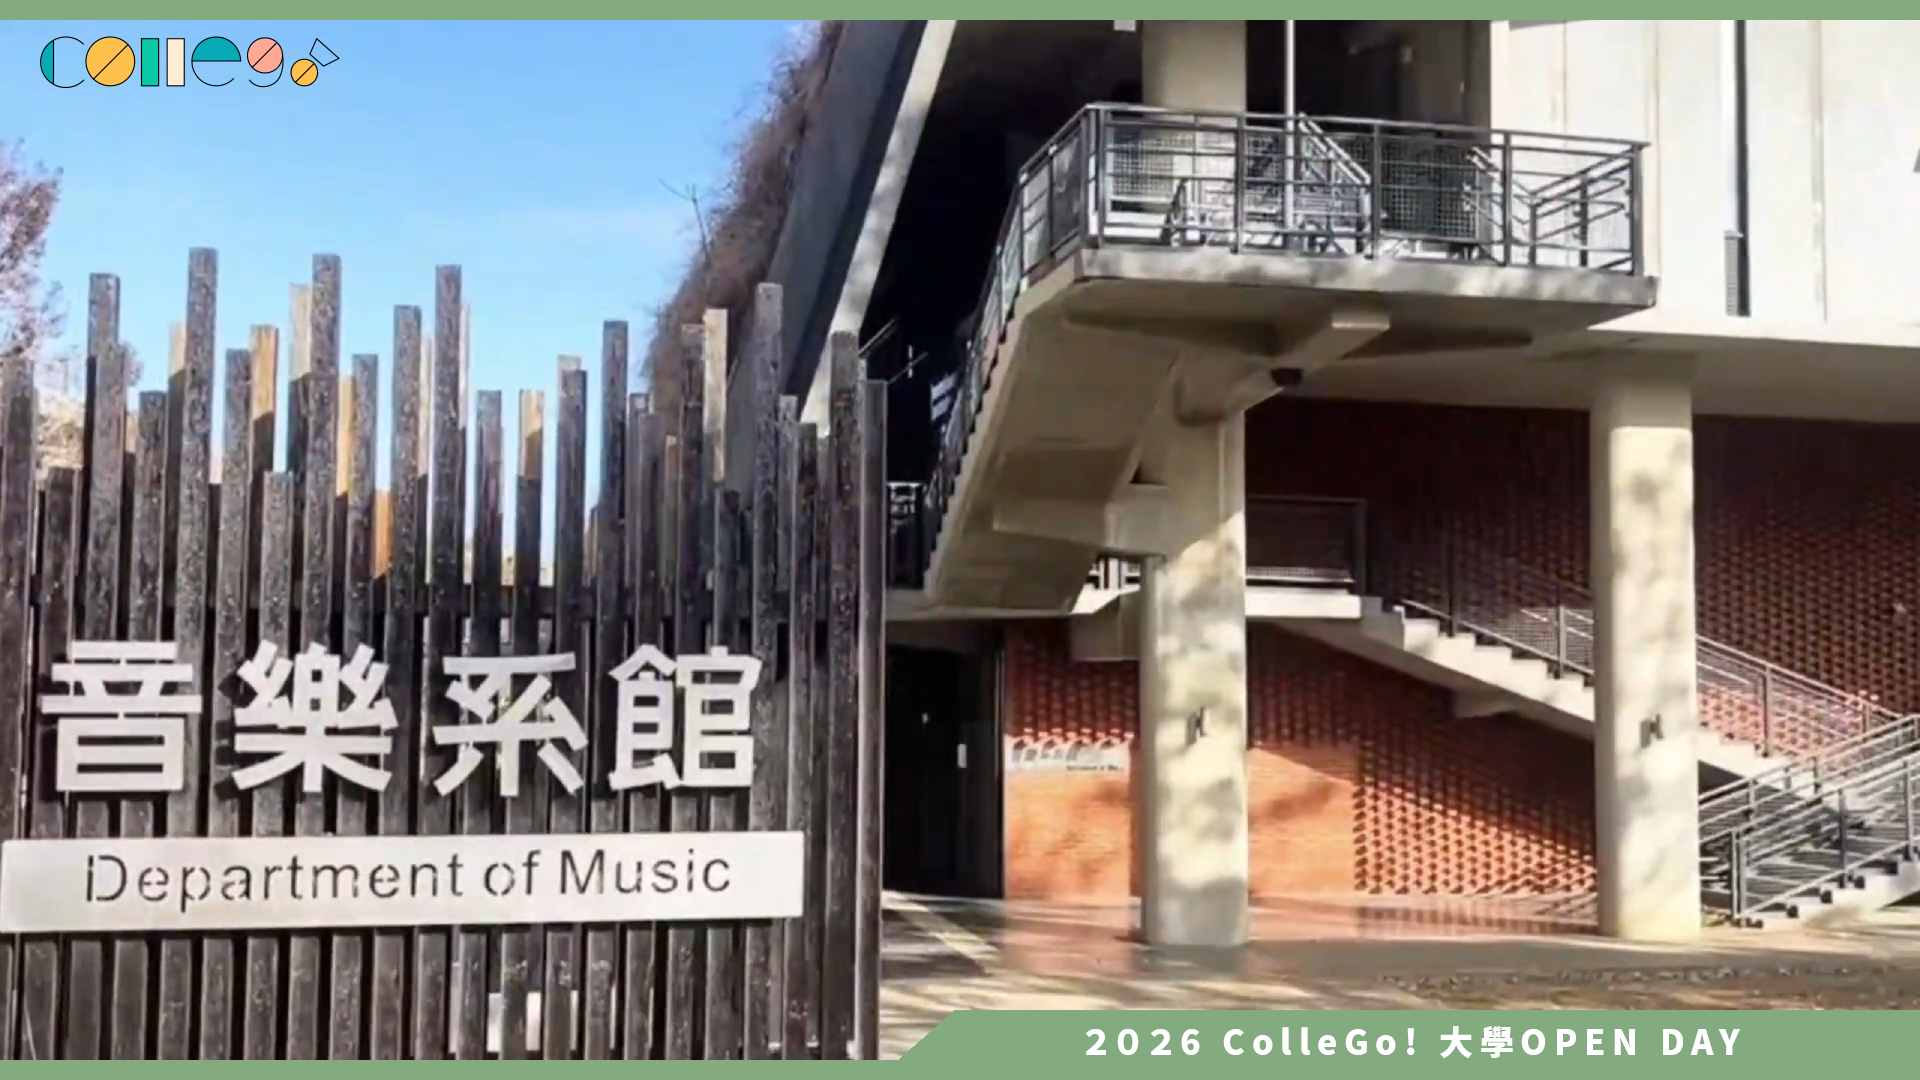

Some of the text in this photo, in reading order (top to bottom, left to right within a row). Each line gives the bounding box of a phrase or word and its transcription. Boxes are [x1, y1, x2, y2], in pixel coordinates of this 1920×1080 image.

[41, 640, 763, 798] 音樂系館
[86, 848, 730, 913] Department of Music
